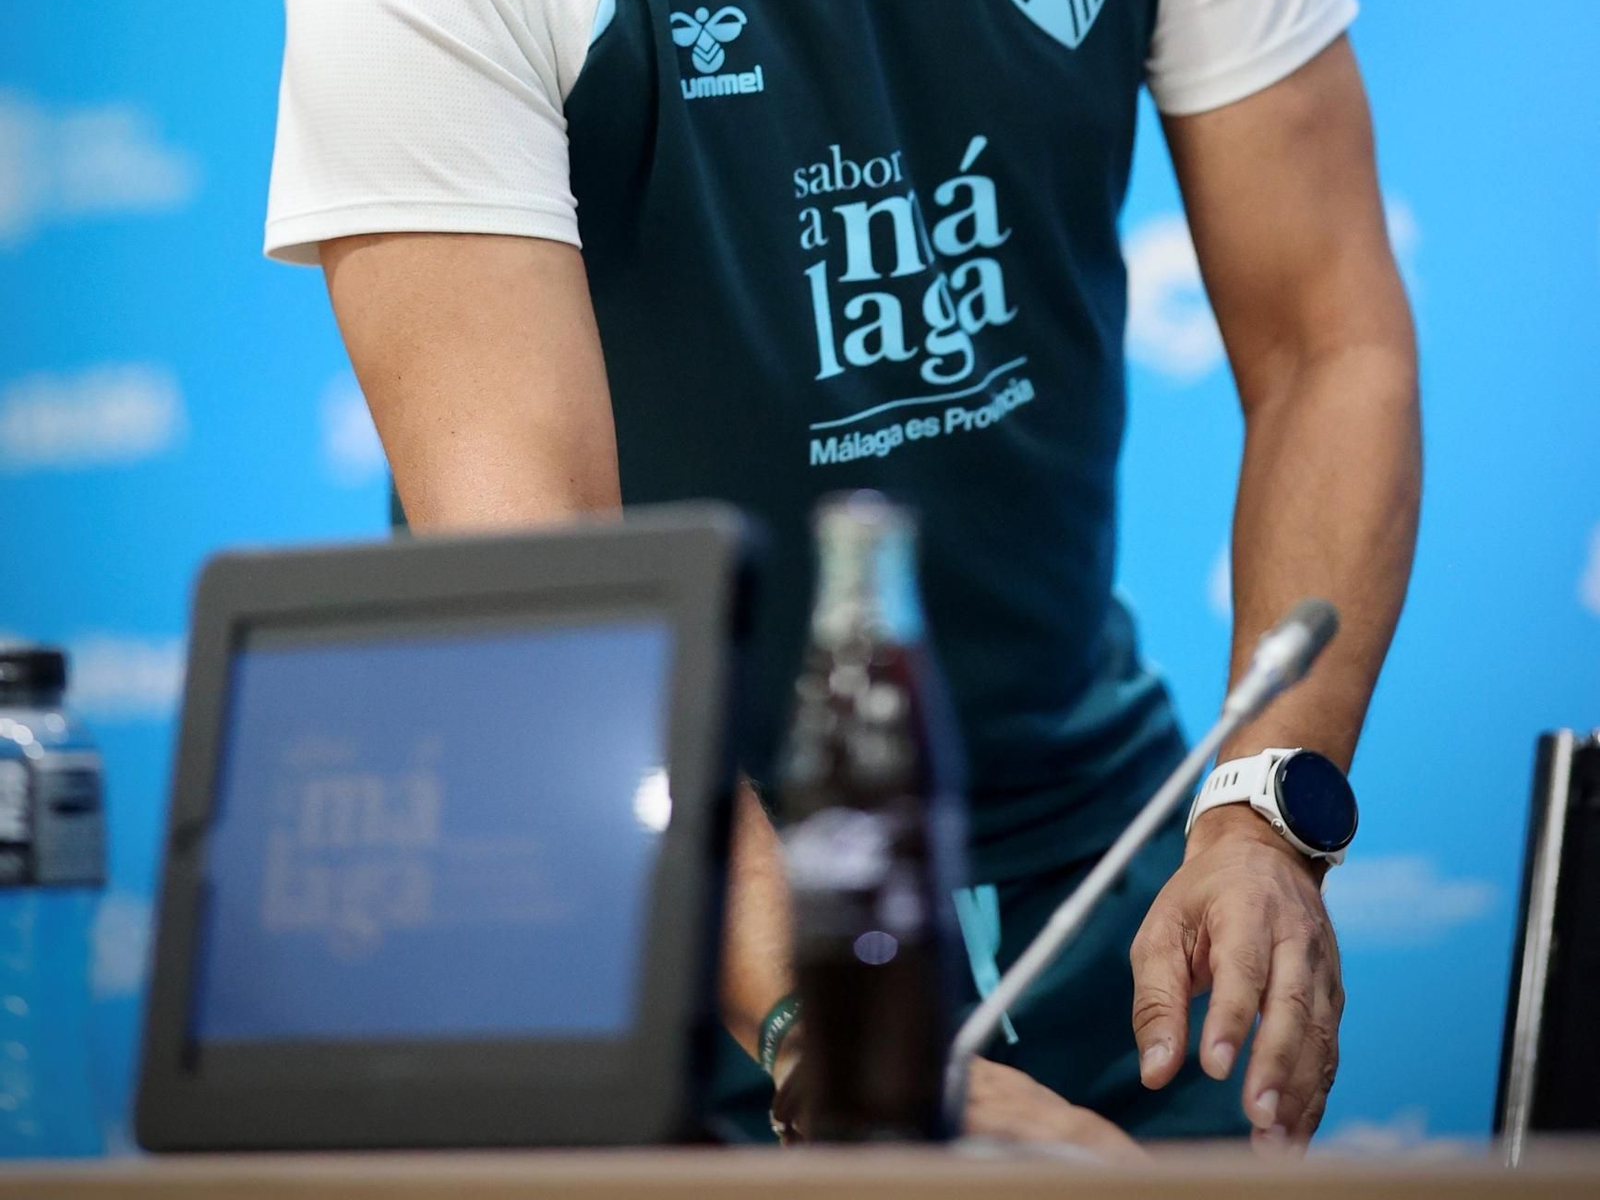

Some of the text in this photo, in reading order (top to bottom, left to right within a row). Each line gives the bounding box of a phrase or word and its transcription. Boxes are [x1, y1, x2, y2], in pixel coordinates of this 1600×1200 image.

[680, 64, 764, 100] ummel
[793, 144, 903, 199] sabor
[799, 206, 829, 250] a
[803, 257, 1019, 386] laga
[809, 377, 1036, 466] Málaga es Procia
